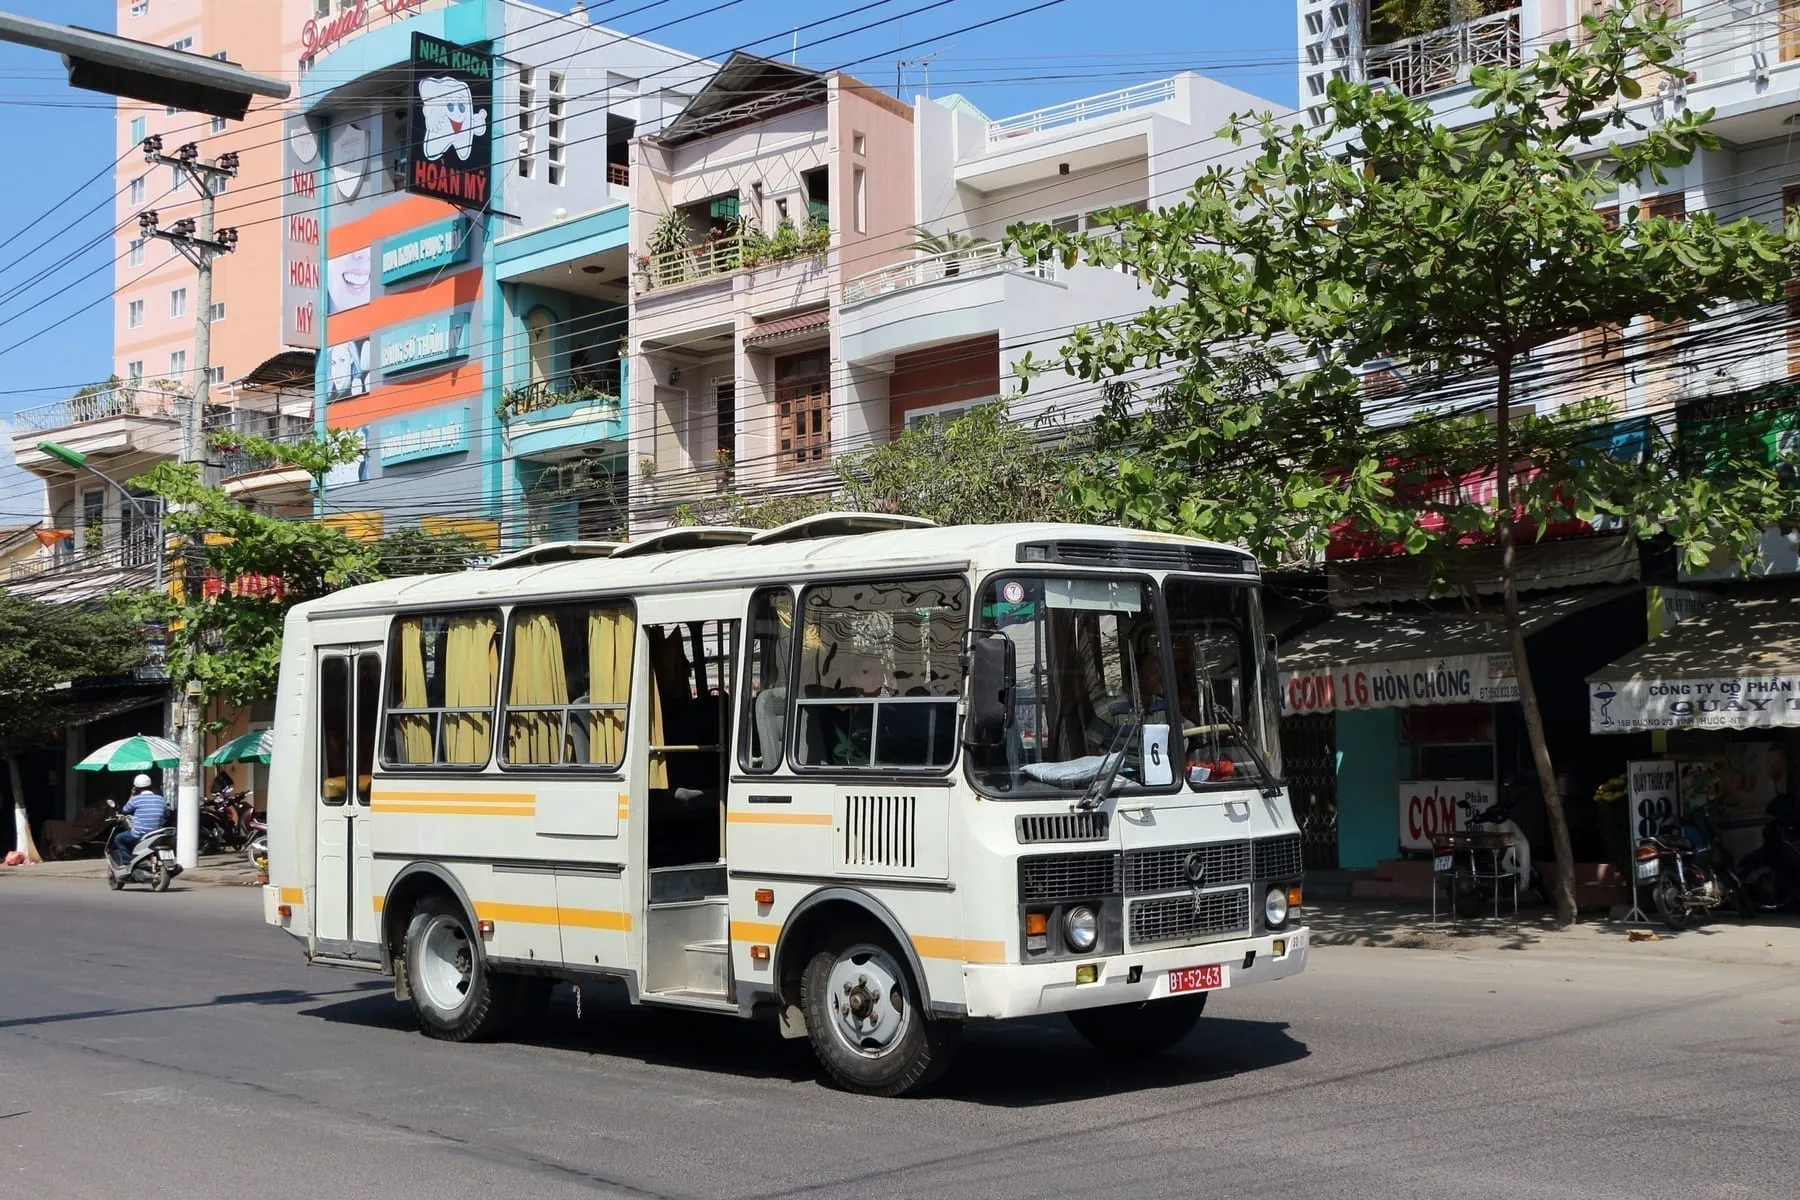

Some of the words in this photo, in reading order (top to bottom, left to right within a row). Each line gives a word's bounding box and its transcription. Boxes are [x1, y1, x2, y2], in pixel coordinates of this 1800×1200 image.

[419, 40, 449, 66] NHA
[452, 51, 490, 79] KHOA
[291, 168, 316, 200] NHA
[415, 158, 461, 196] HOÀN
[464, 169, 487, 202] MỸ
[290, 215, 320, 244] KHOA
[289, 256, 320, 289] HOÀN
[295, 301, 314, 334] MỸ
[1288, 670, 1337, 711] CƠM
[1342, 671, 1370, 706] 16
[1372, 668, 1410, 702] HÒN
[1413, 659, 1470, 699] CHỒNG
[1649, 682, 1691, 696] CÔNG
[1695, 684, 1714, 695] TY
[1747, 675, 1792, 693] PHẦN
[1150, 742, 1161, 766] 6
[1408, 785, 1457, 840] CƠM
